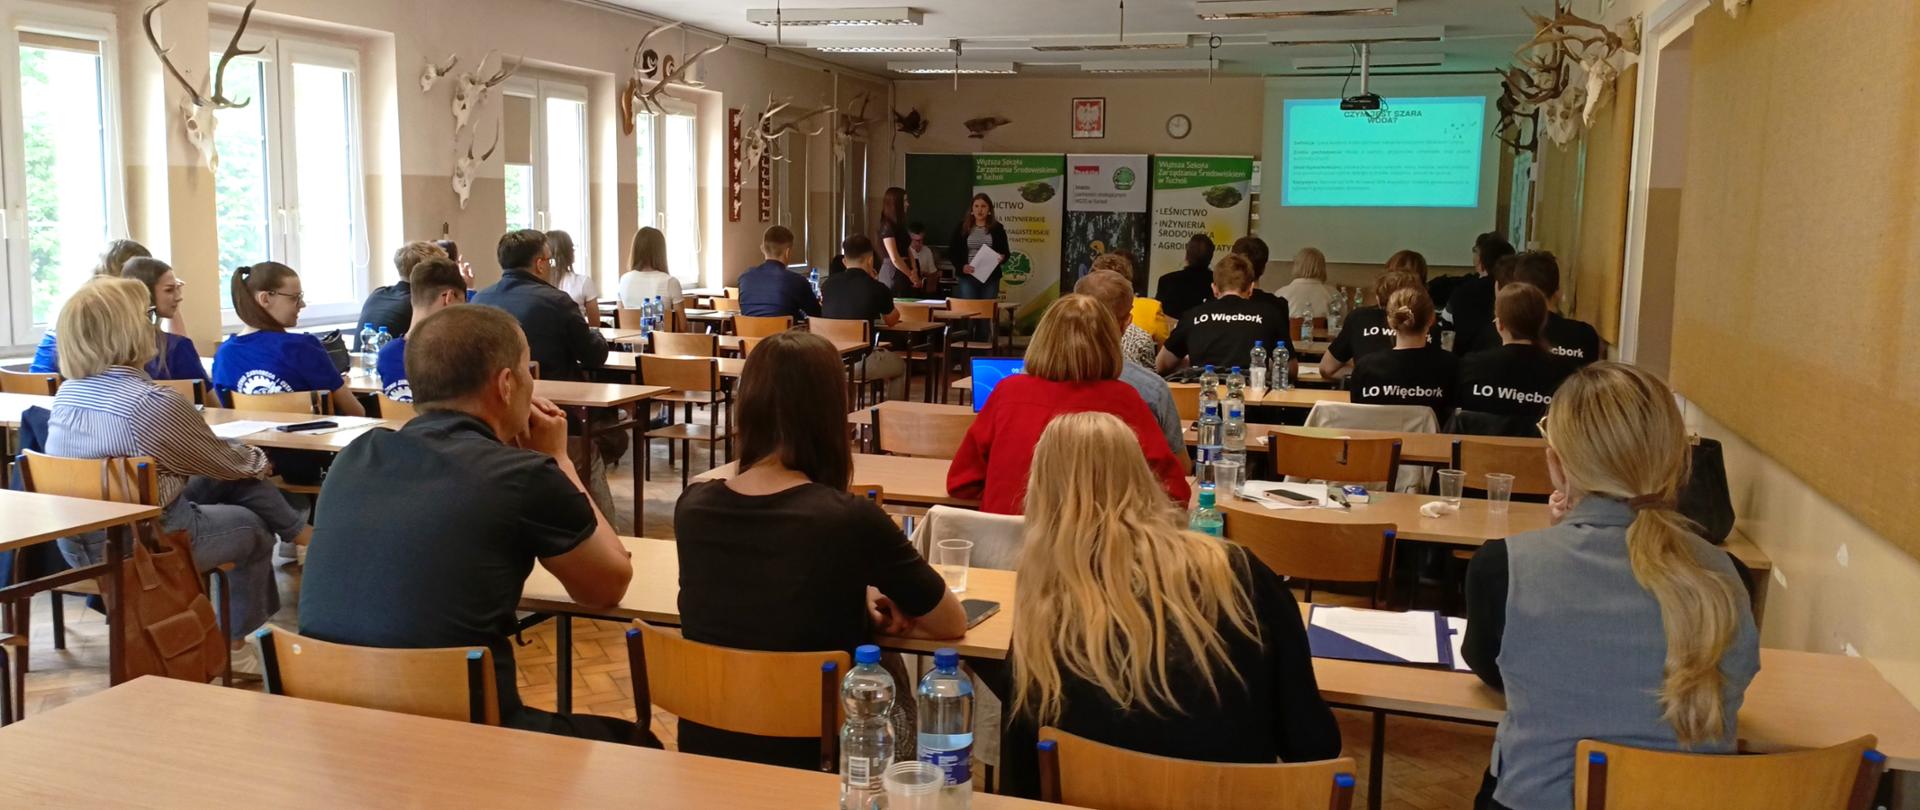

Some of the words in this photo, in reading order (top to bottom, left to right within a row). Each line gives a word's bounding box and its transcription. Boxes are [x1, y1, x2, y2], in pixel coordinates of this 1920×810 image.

[1394, 110, 1423, 118] SZARA
[992, 201, 1024, 209] NICTWO
[1160, 206, 1208, 217] LEŚNICTWO
[1159, 219, 1206, 229] INŻYNIERIA
[1193, 313, 1209, 325] LO
[1211, 312, 1263, 325] Więcbork
[1363, 326, 1380, 337] LO
[1550, 345, 1585, 359] cbork
[1362, 385, 1380, 398] LO
[1382, 384, 1444, 399] Więcbork
[1472, 383, 1494, 397] LO
[1497, 386, 1553, 405] Więcbo
